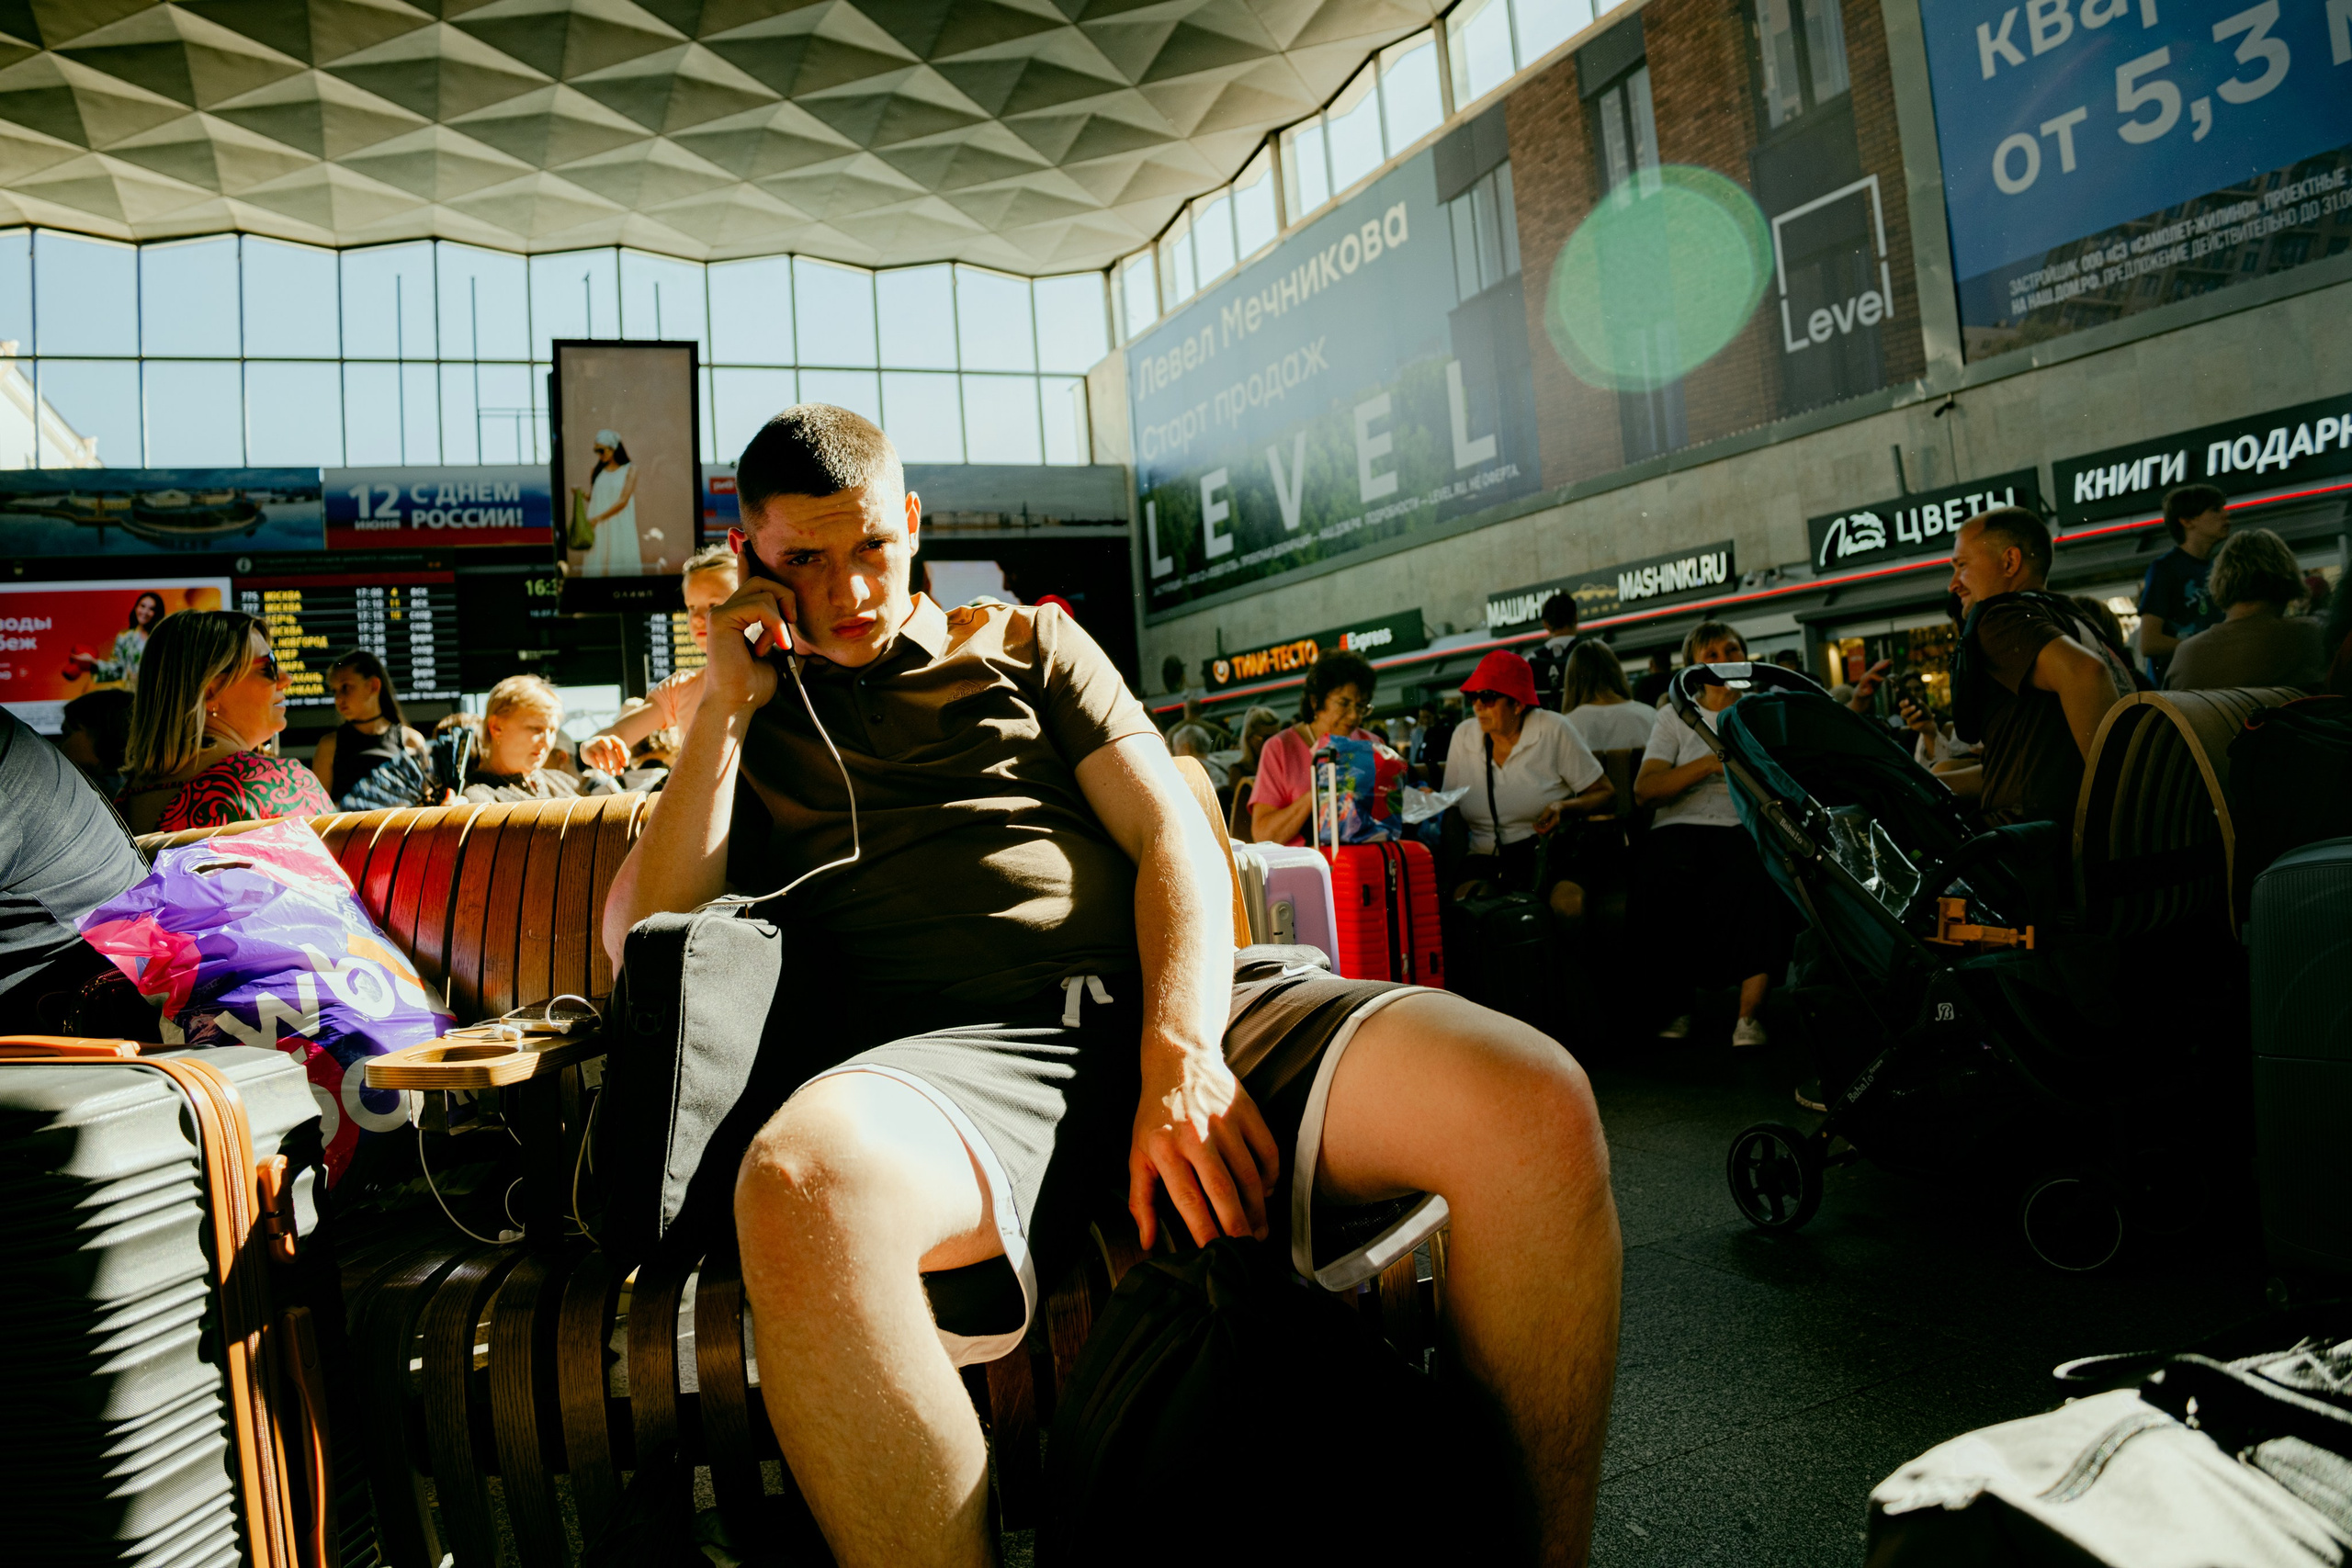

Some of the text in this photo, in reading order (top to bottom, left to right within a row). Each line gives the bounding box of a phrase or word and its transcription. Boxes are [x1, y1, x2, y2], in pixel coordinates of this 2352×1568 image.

[2114, 0, 2291, 144] 5,3
[2263, 166, 2347, 210] ПРОЕКТНЫЕ
[2191, 208, 2298, 260] ДЕЙСТВИТЕЛЬНО
[2299, 199, 2321, 225] ДО
[1137, 200, 1409, 401] Левел Мечникова
[1781, 261, 1894, 353] Level
[1141, 335, 1330, 461] Старт продаж
[1146, 360, 1498, 580] LEVEL
[2074, 449, 2188, 504] КНИГИ
[348, 483, 401, 519] 12
[410, 482, 430, 504] С
[412, 507, 523, 530] РОССИИ!
[264, 590, 302, 603] МОСКВА
[1618, 551, 1727, 602] MASHINKI.RU
[265, 602, 303, 614] МОСКВА
[1486, 588, 1560, 628] МАШИН
[270, 636, 329, 649] .НОВГОРОД
[1847, 1075, 1874, 1103] Babalo
